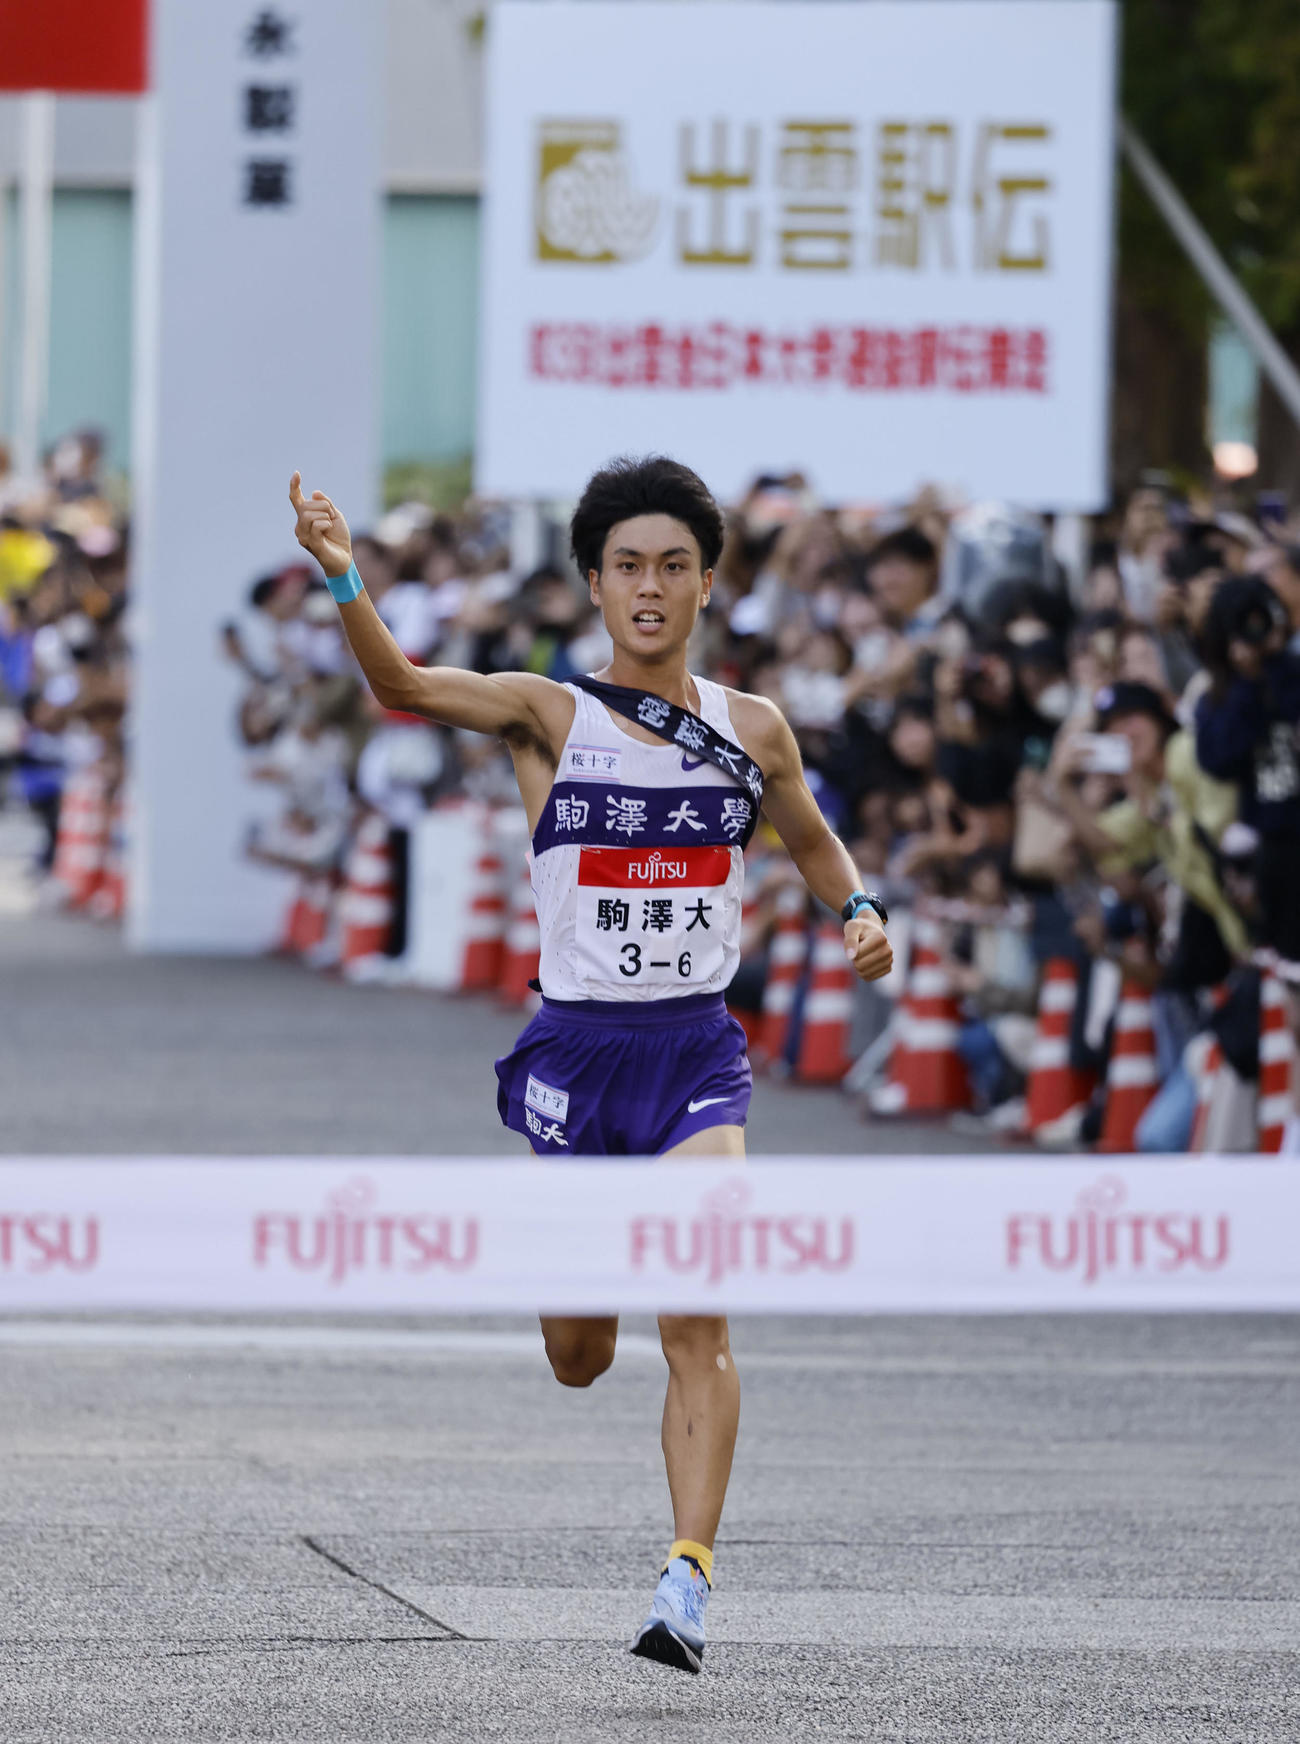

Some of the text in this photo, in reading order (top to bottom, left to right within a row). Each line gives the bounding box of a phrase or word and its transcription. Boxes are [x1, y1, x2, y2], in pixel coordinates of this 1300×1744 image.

[677, 118, 1050, 270] 出雲駅伝
[571, 752, 617, 769] 桜十字
[627, 852, 687, 884] FUJITSU
[596, 898, 713, 933] 駒澤大
[525, 1106, 569, 1147] 駒大
[253, 1178, 480, 1285] FUJITSU
[629, 1178, 855, 1286] FUJITSU
[1005, 1178, 1230, 1285] FUJITSU
